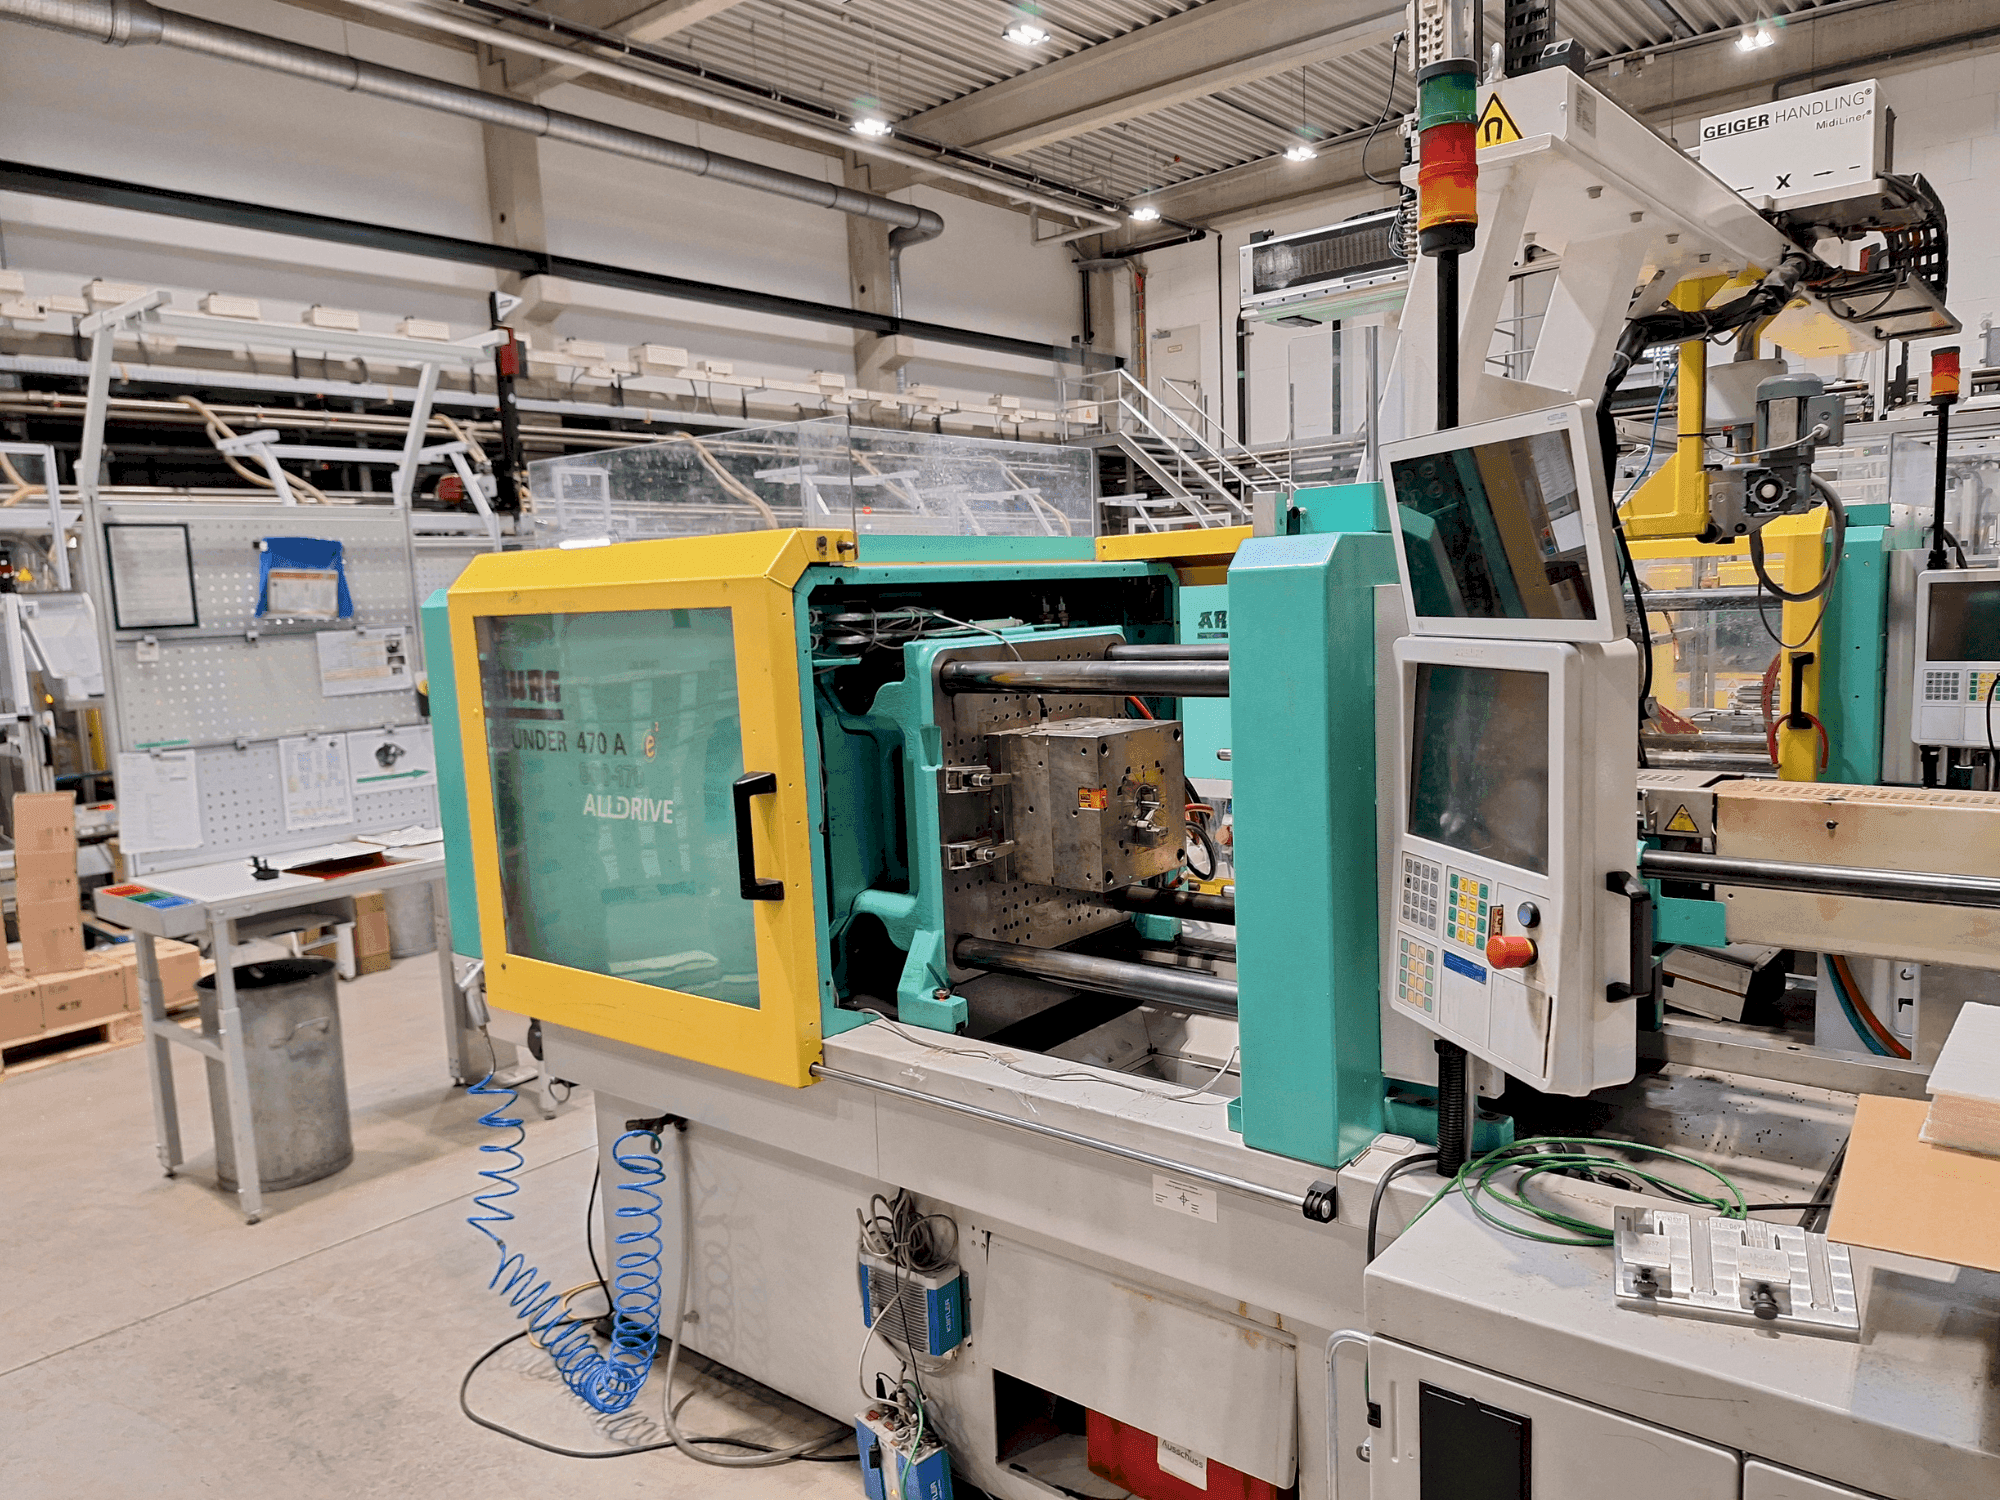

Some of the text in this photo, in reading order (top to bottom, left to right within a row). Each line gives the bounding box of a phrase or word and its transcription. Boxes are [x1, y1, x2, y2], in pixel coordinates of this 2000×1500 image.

[1704, 114, 1769, 138] GEIGER
[1776, 173, 1792, 190] X
[1198, 610, 1228, 629] AR
[511, 729, 567, 753] UNDER
[577, 731, 608, 755] 470
[613, 733, 627, 756] A
[583, 793, 673, 824] ALLDRIVE
[1162, 1439, 1204, 1469] Ausschuss
